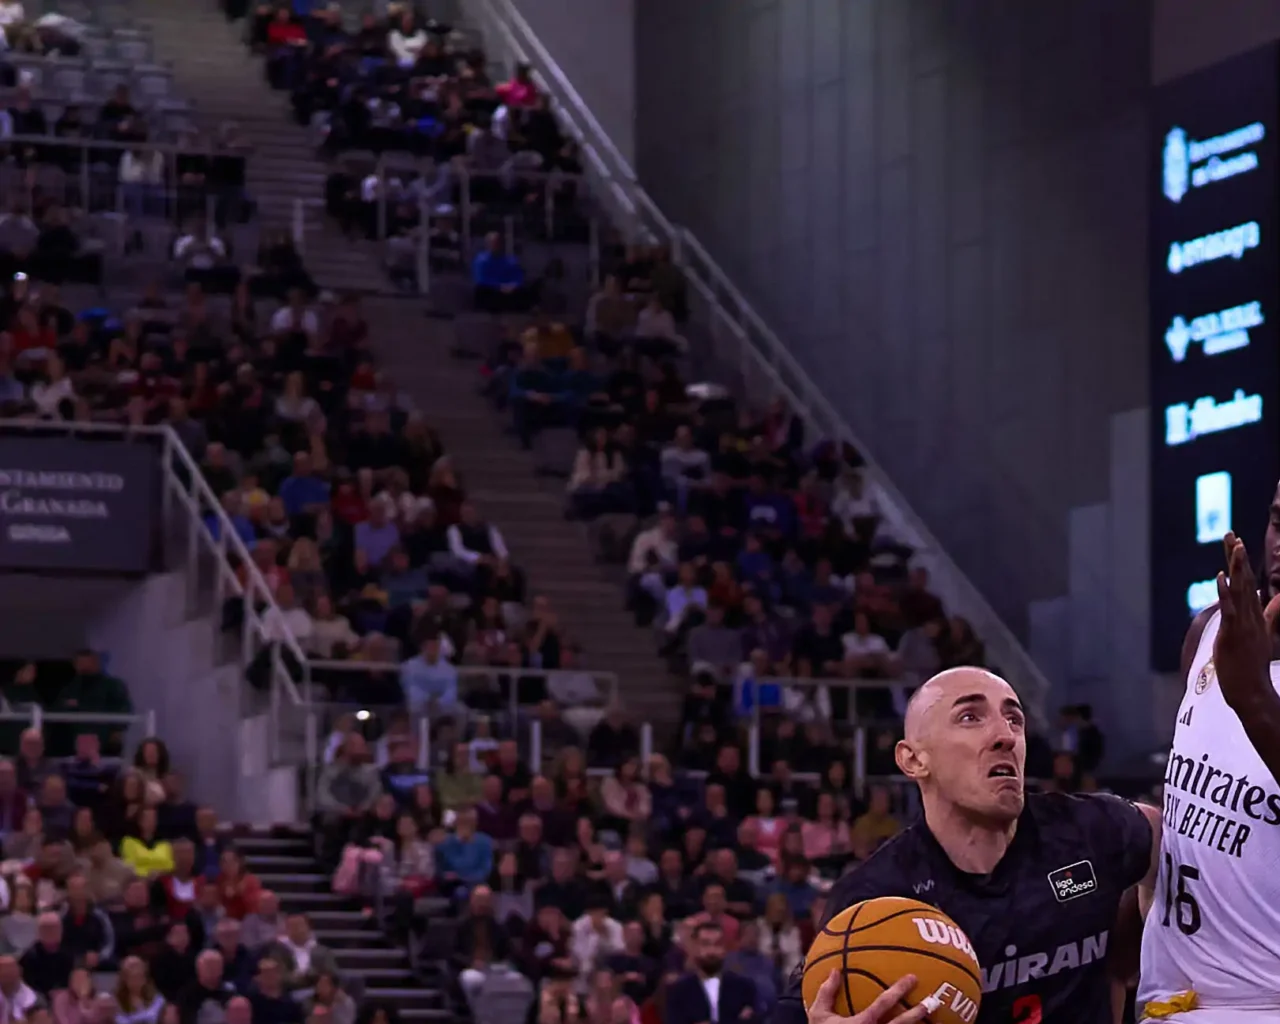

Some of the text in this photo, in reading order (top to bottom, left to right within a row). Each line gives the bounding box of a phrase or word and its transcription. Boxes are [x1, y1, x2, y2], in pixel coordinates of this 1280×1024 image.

[1178, 803, 1251, 858] BETTER
[1162, 852, 1202, 936] 16
[979, 930, 1109, 993] VIRAN
